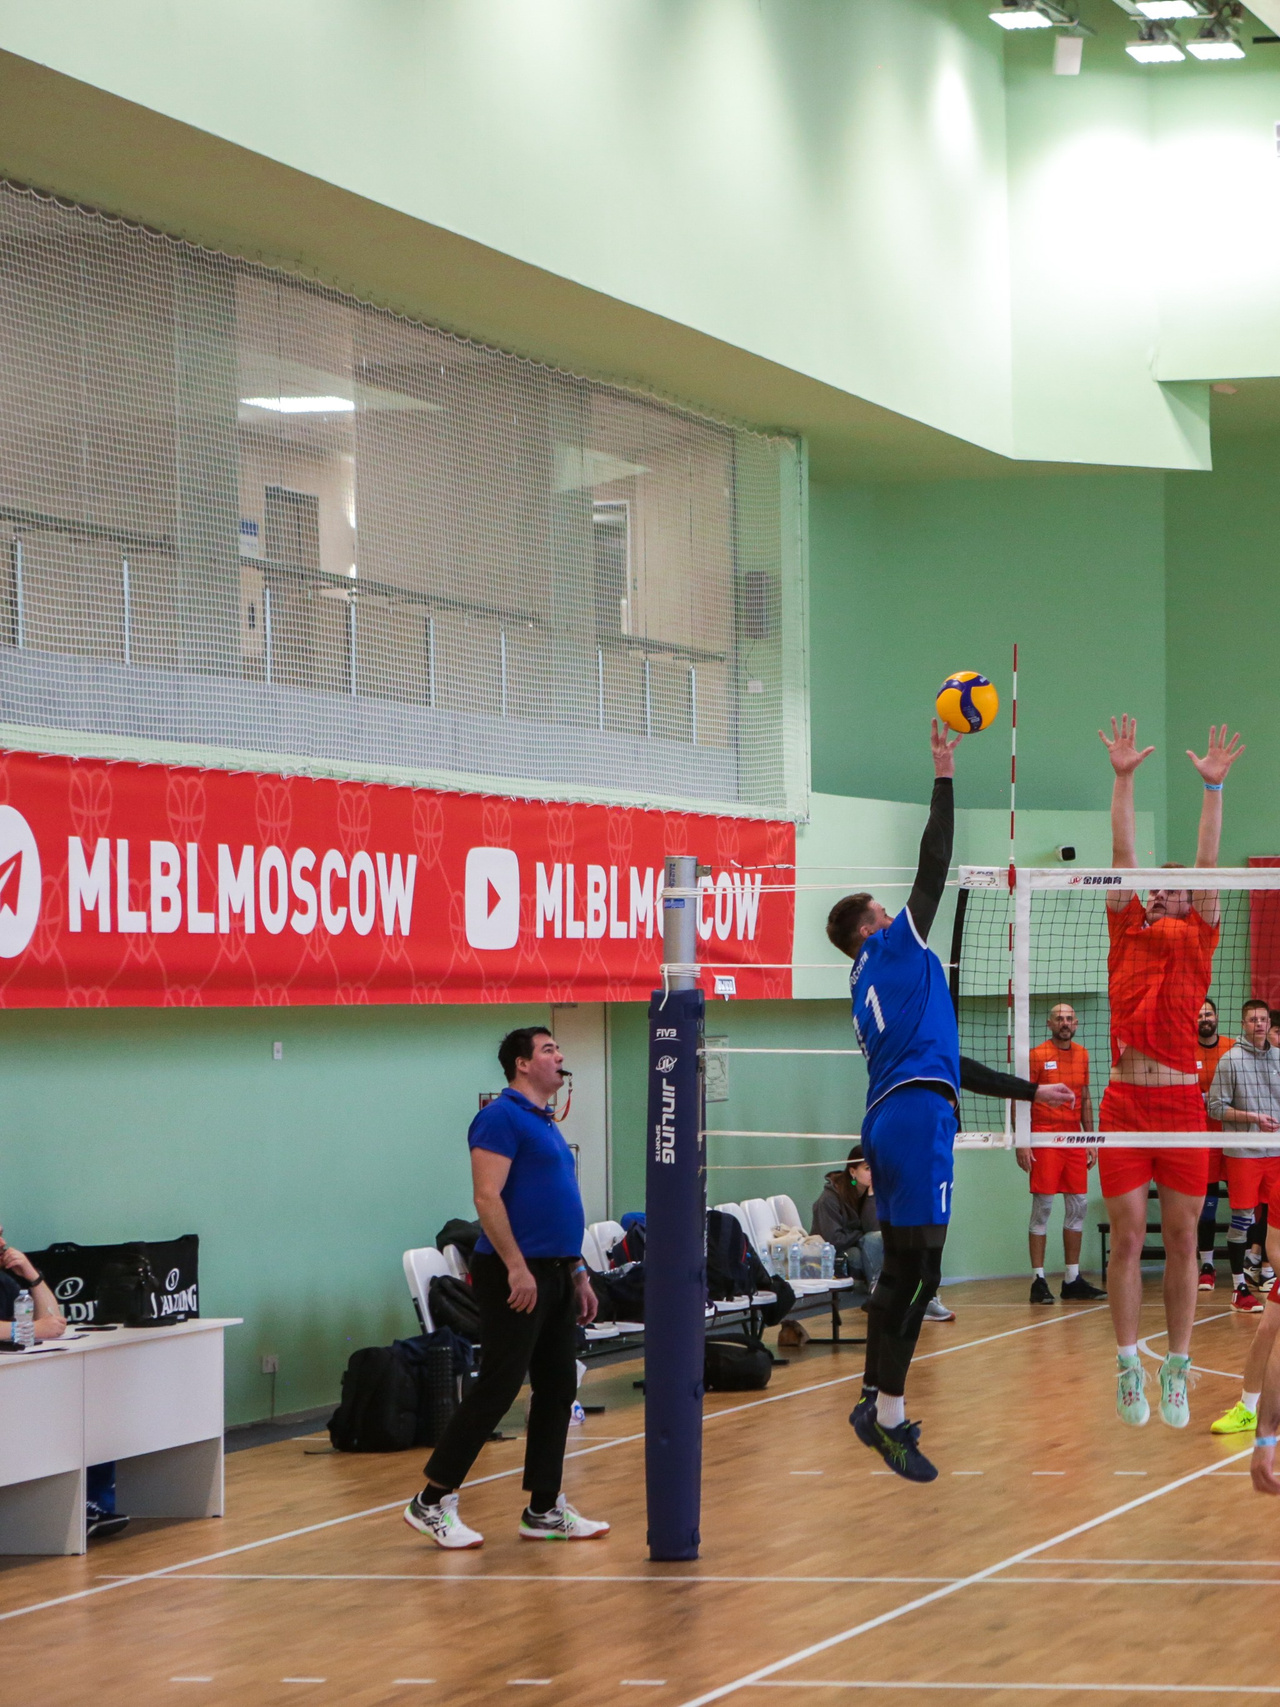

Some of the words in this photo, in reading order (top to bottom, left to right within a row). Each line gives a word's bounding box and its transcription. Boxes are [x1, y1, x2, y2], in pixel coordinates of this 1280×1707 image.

[67, 835, 417, 937] MLBLMOSCOW
[535, 861, 763, 941] MLBLMCOW
[656, 1028, 677, 1038] FIVB
[661, 1077, 676, 1165] JINLING
